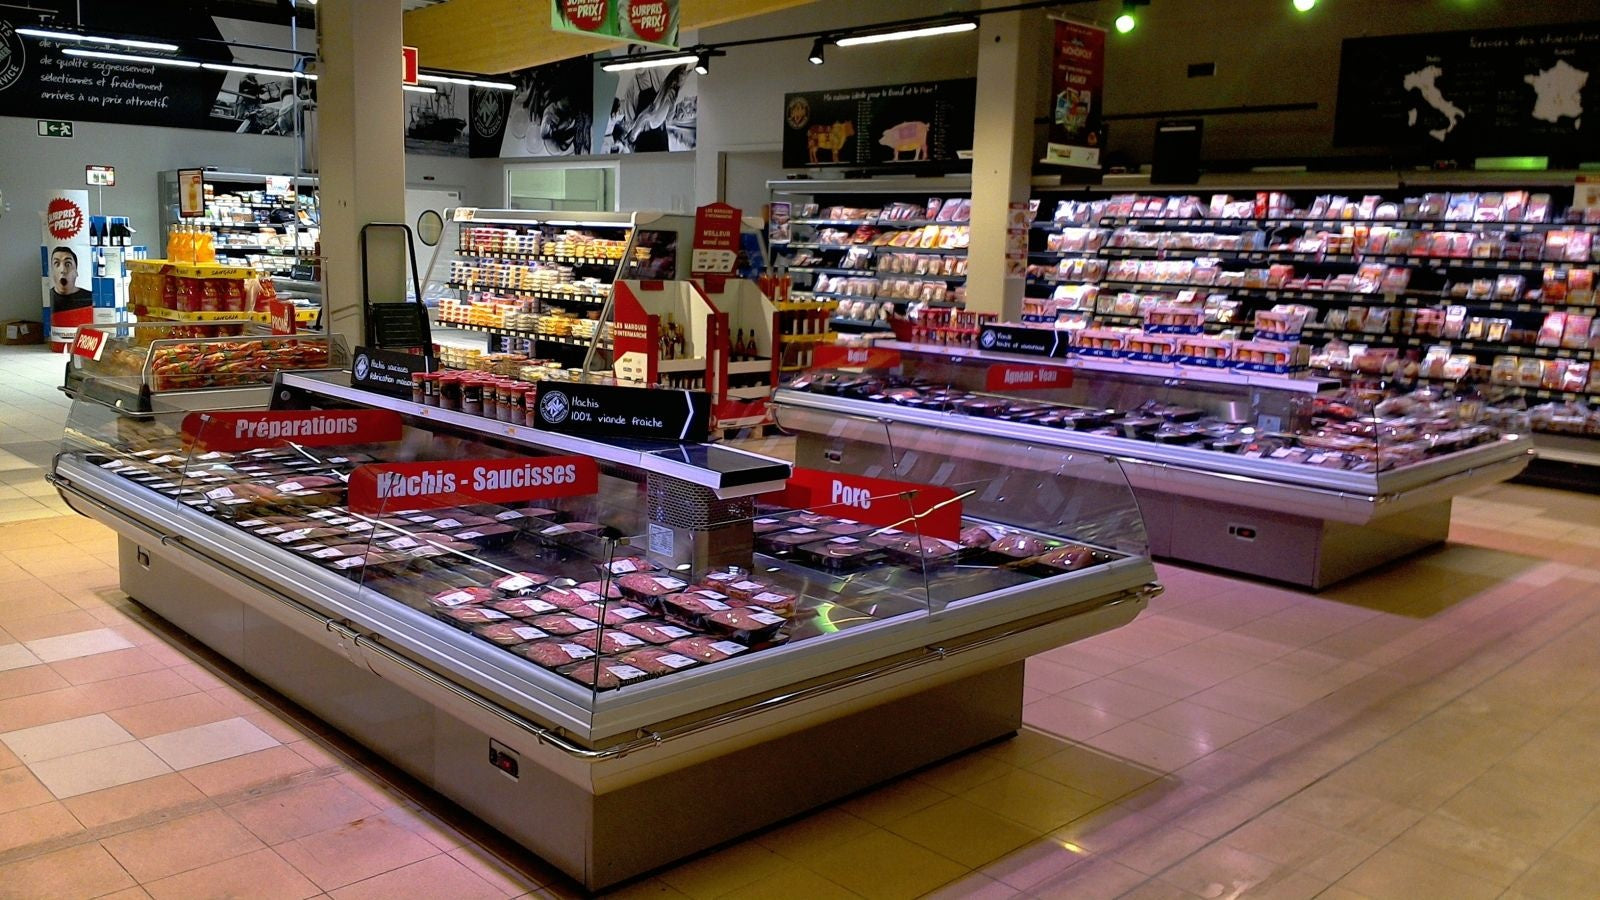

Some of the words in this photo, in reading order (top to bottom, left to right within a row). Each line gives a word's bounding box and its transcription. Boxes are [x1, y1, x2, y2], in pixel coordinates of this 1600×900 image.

[577, 2, 605, 18] PRIX!
[641, 14, 667, 29] PRIX!
[40, 55, 52, 64] de
[56, 58, 88, 69] qualité
[93, 61, 155, 76] soigneusement
[97, 77, 106, 87] et
[41, 90, 75, 101] arrivés
[88, 95, 100, 103] un
[102, 94, 122, 107] prix
[624, 323, 647, 331] MARQUES
[77, 334, 99, 351] PROMO
[1004, 369, 1034, 384] Agneau
[1039, 369, 1057, 382] Veau
[571, 396, 600, 408] Hachis
[571, 411, 592, 422] 100%
[597, 413, 627, 425] viande
[235, 416, 358, 439] Préparations
[376, 470, 456, 499] Hachis
[473, 463, 576, 492] Saucisses
[832, 479, 871, 510] Porc
